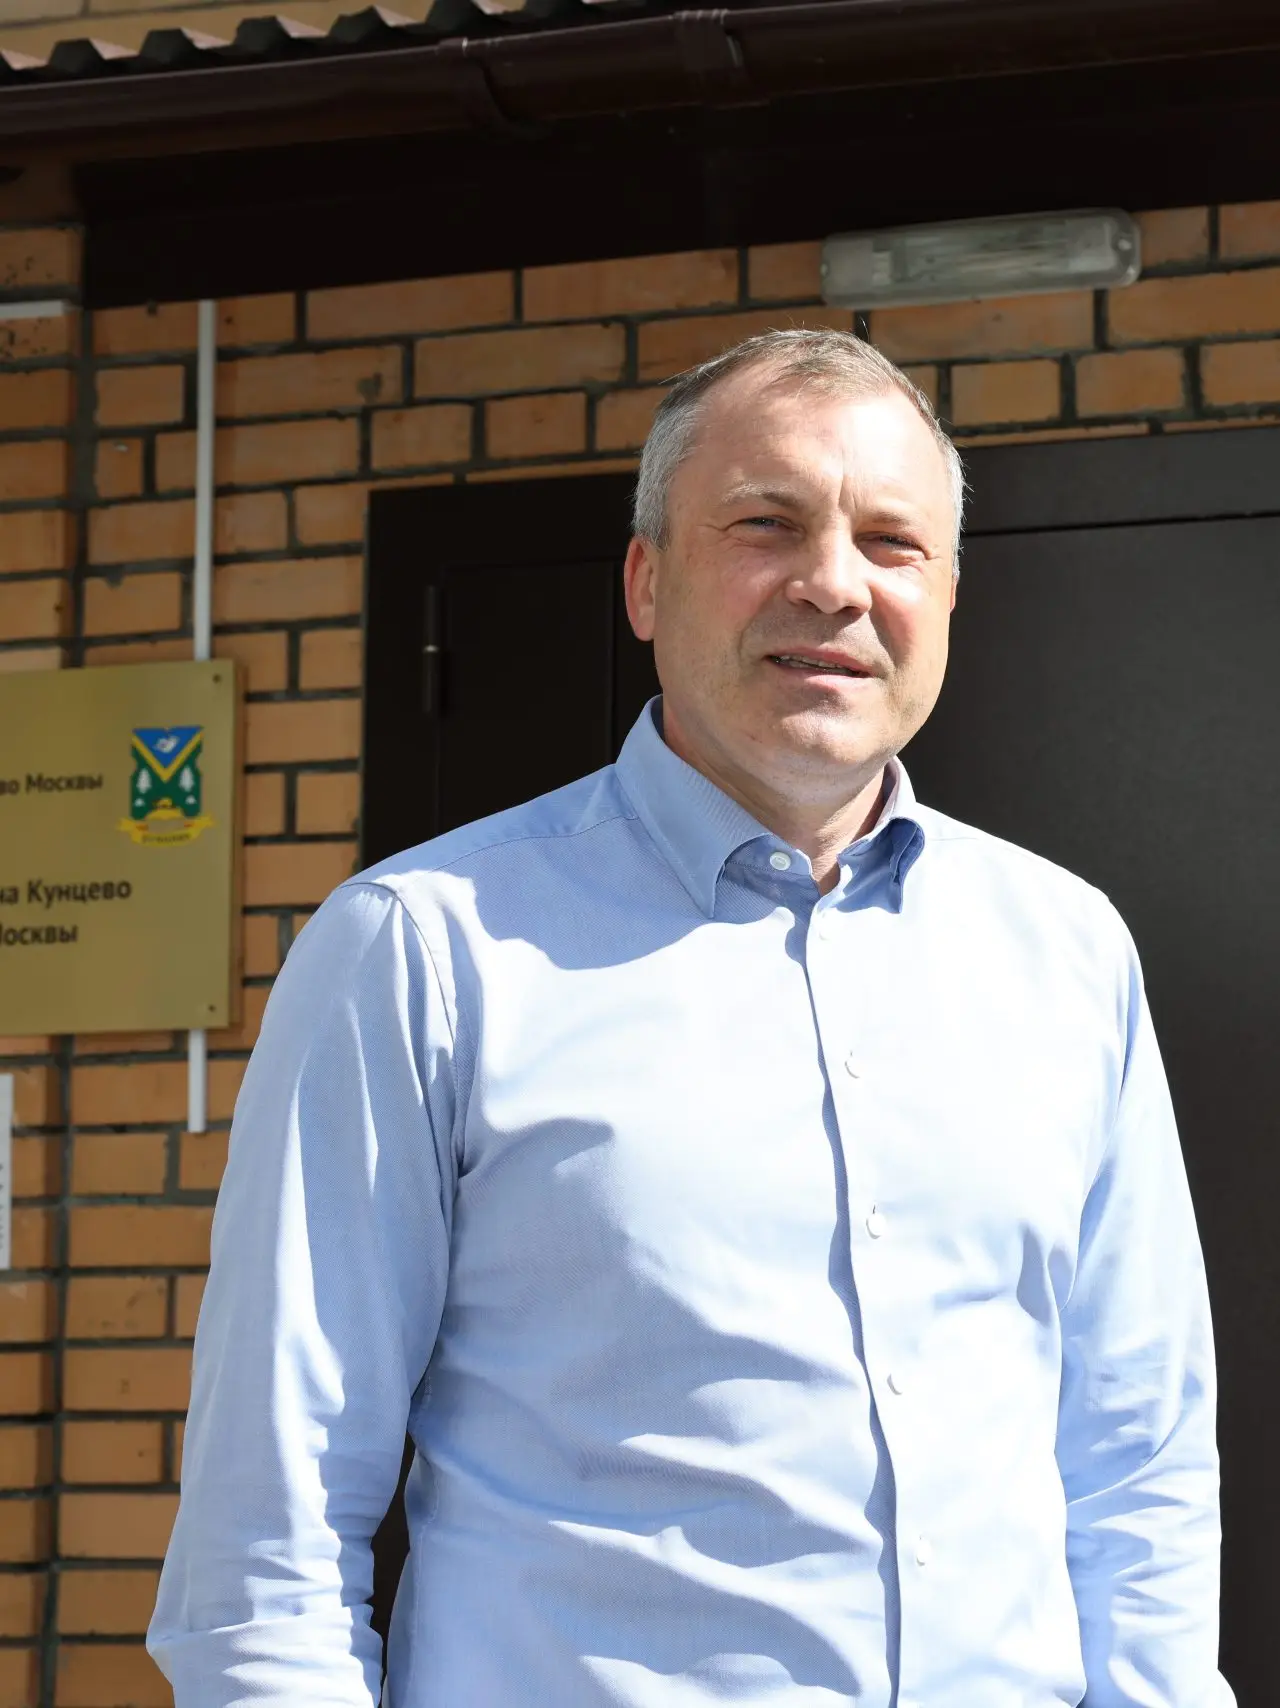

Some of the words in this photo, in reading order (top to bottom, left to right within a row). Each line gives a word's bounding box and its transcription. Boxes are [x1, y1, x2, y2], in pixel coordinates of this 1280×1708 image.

[25, 773, 103, 794] Москвы
[27, 879, 132, 909] Кунцево
[0, 923, 78, 947] осквы
